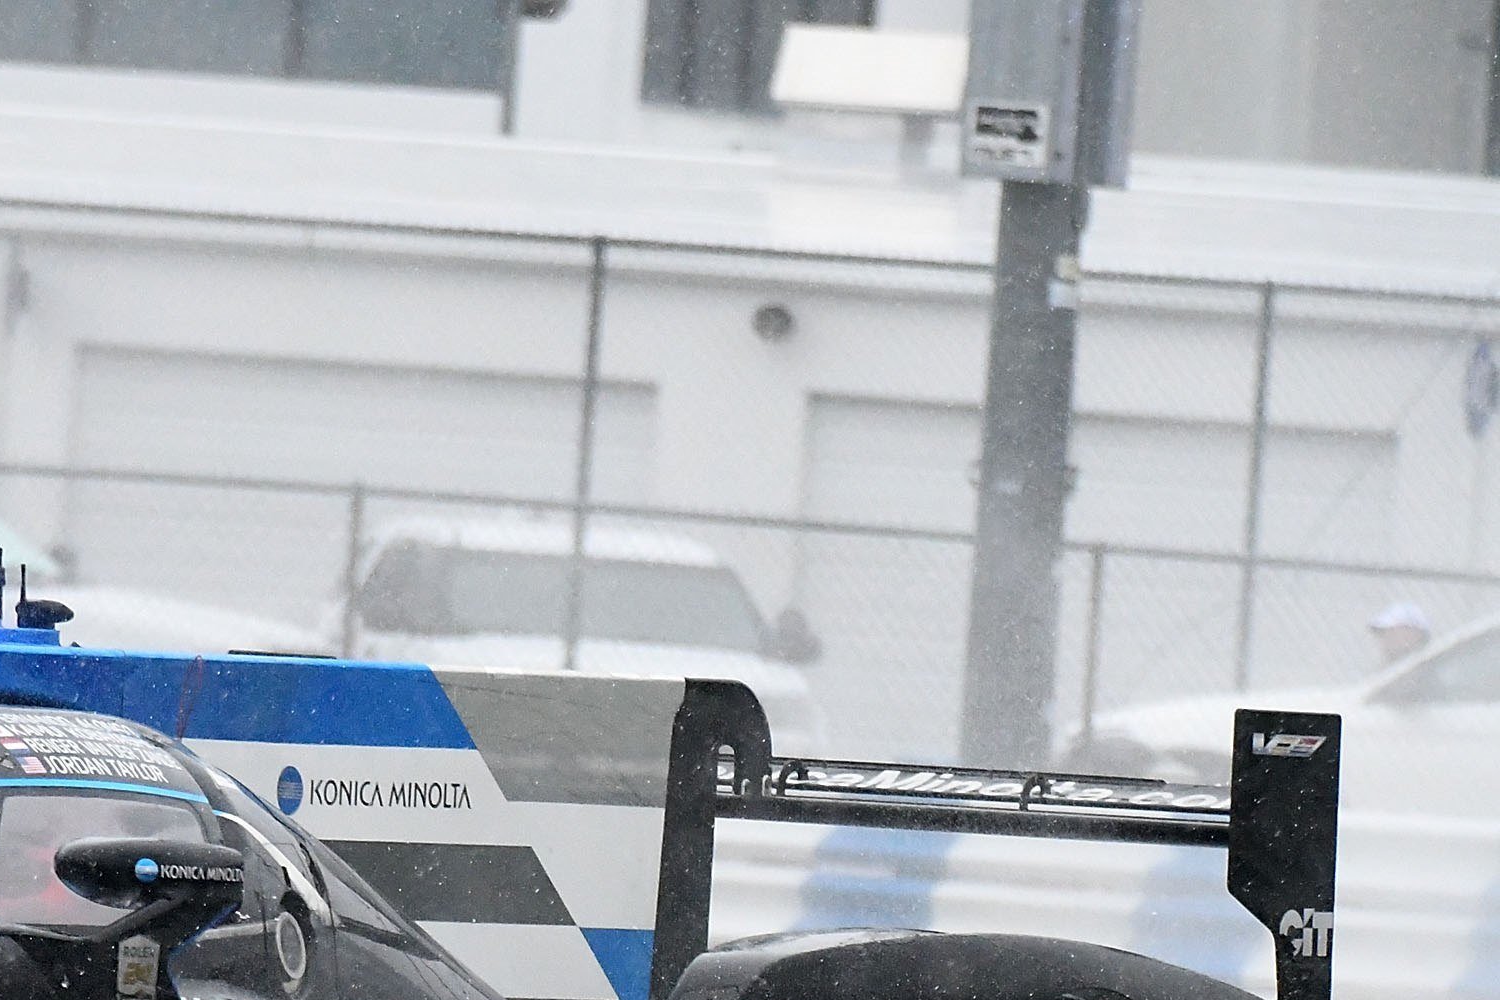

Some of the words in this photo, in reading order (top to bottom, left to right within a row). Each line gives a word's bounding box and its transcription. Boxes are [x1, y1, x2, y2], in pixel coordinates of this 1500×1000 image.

[22, 738, 86, 754] RENGER
[78, 741, 115, 757] VAN
[44, 756, 113, 776] JORDAN
[107, 759, 169, 783] TAYLOR
[310, 780, 384, 807] KONICA
[389, 782, 472, 809] MINOLTA
[160, 864, 205, 880] KONICA
